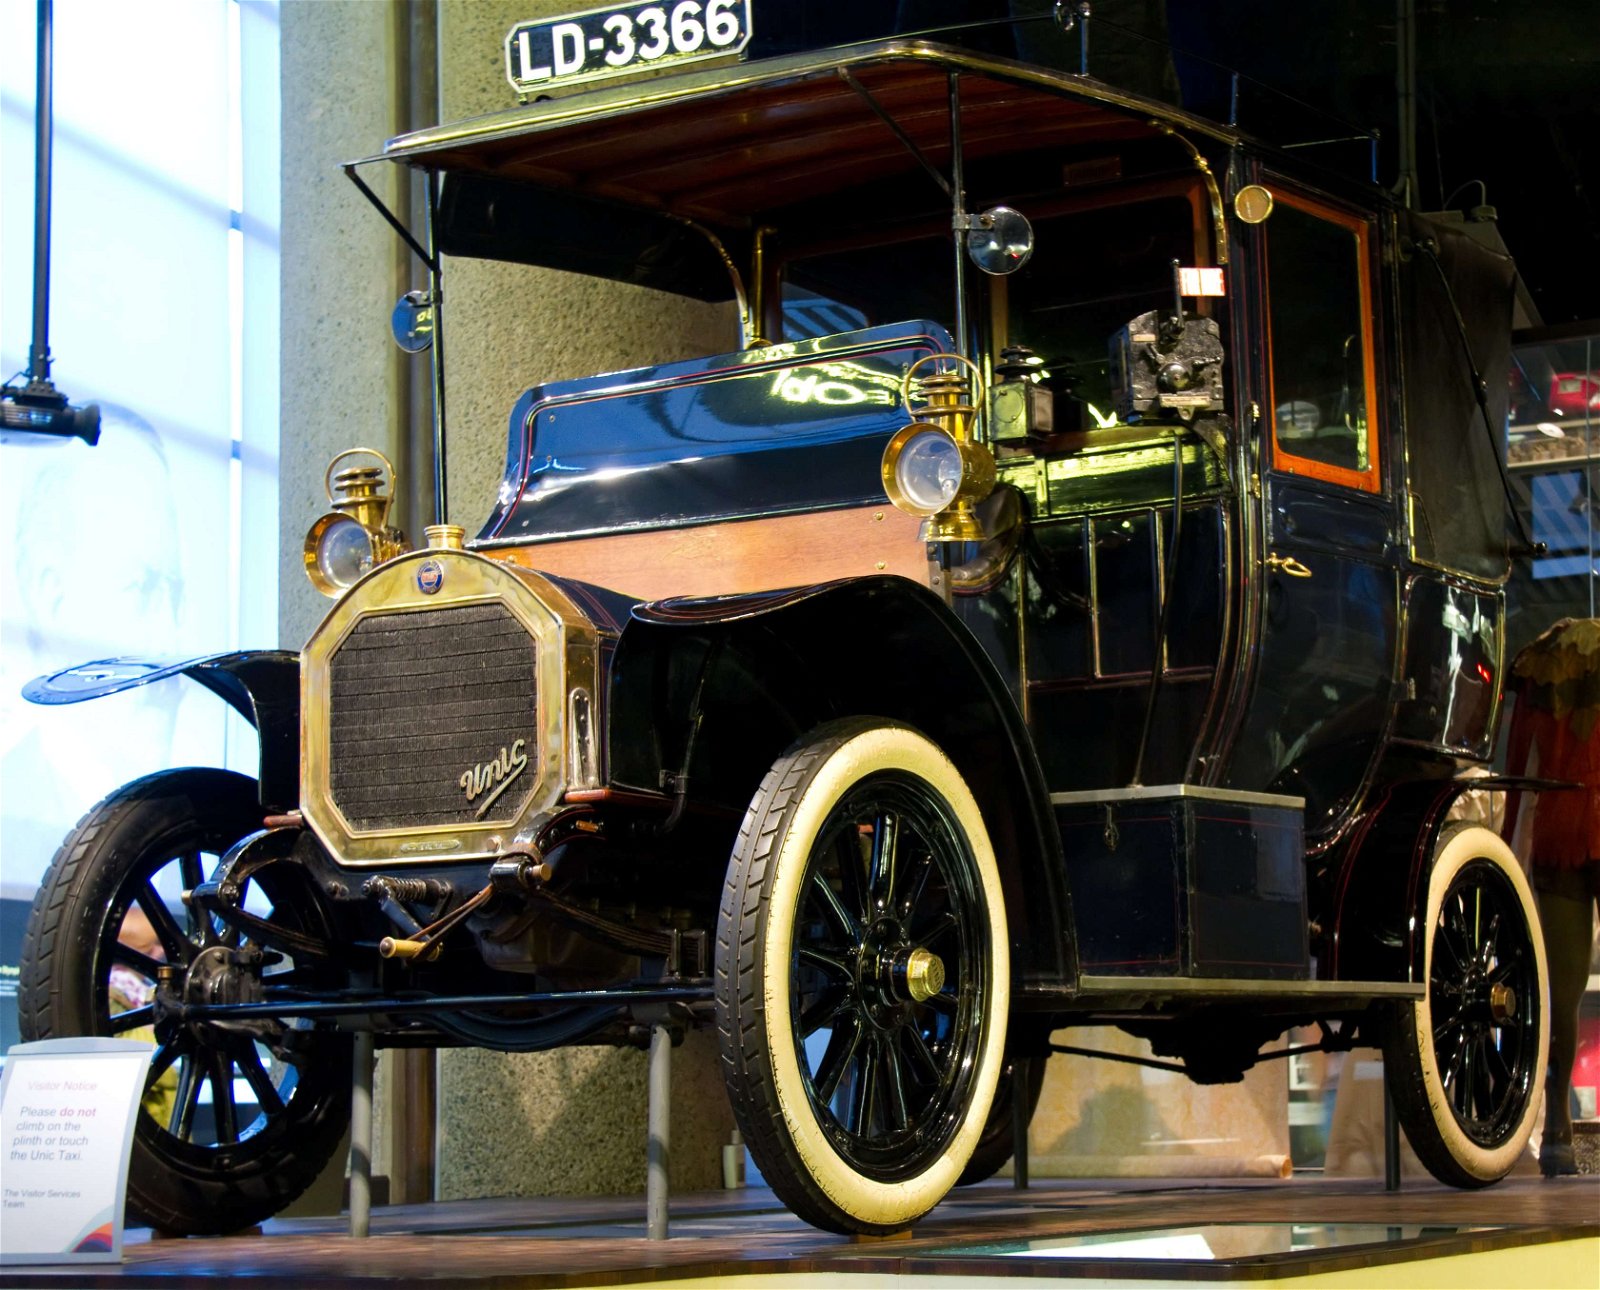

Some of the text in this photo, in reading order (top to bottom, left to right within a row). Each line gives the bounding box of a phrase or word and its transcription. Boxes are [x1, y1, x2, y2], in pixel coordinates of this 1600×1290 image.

[518, 0, 740, 81] LD-3366
[460, 739, 527, 818] Unic
[28, 1081, 98, 1091] Visitor Notice
[20, 1106, 96, 1117] Please do not
[16, 1122, 81, 1132] climb on the
[12, 1136, 88, 1147] plinth or touch
[10, 1150, 83, 1161] the Unic Taxi.
[4, 1189, 81, 1198] The Visitor Services
[3, 1200, 25, 1208] Team
